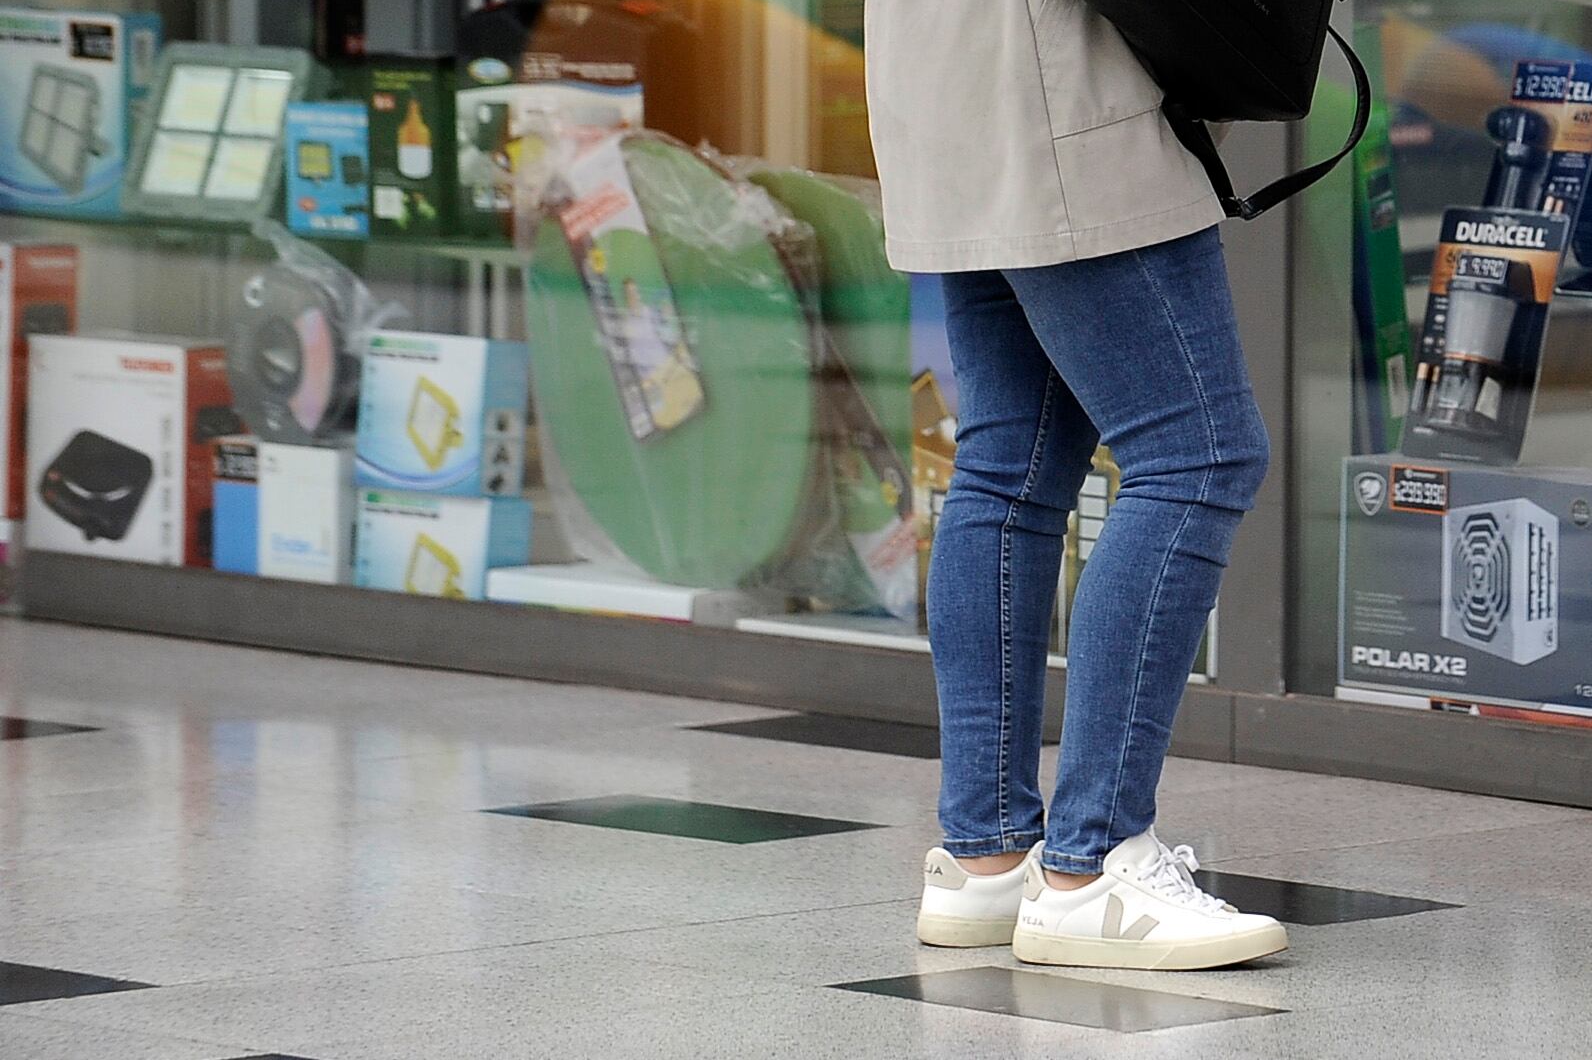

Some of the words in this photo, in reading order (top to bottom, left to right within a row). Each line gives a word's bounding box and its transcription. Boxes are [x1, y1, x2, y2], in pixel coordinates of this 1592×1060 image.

[1456, 221, 1546, 248] DURACELL
[1352, 646, 1432, 672] POLAR
[1434, 654, 1467, 676] X2
